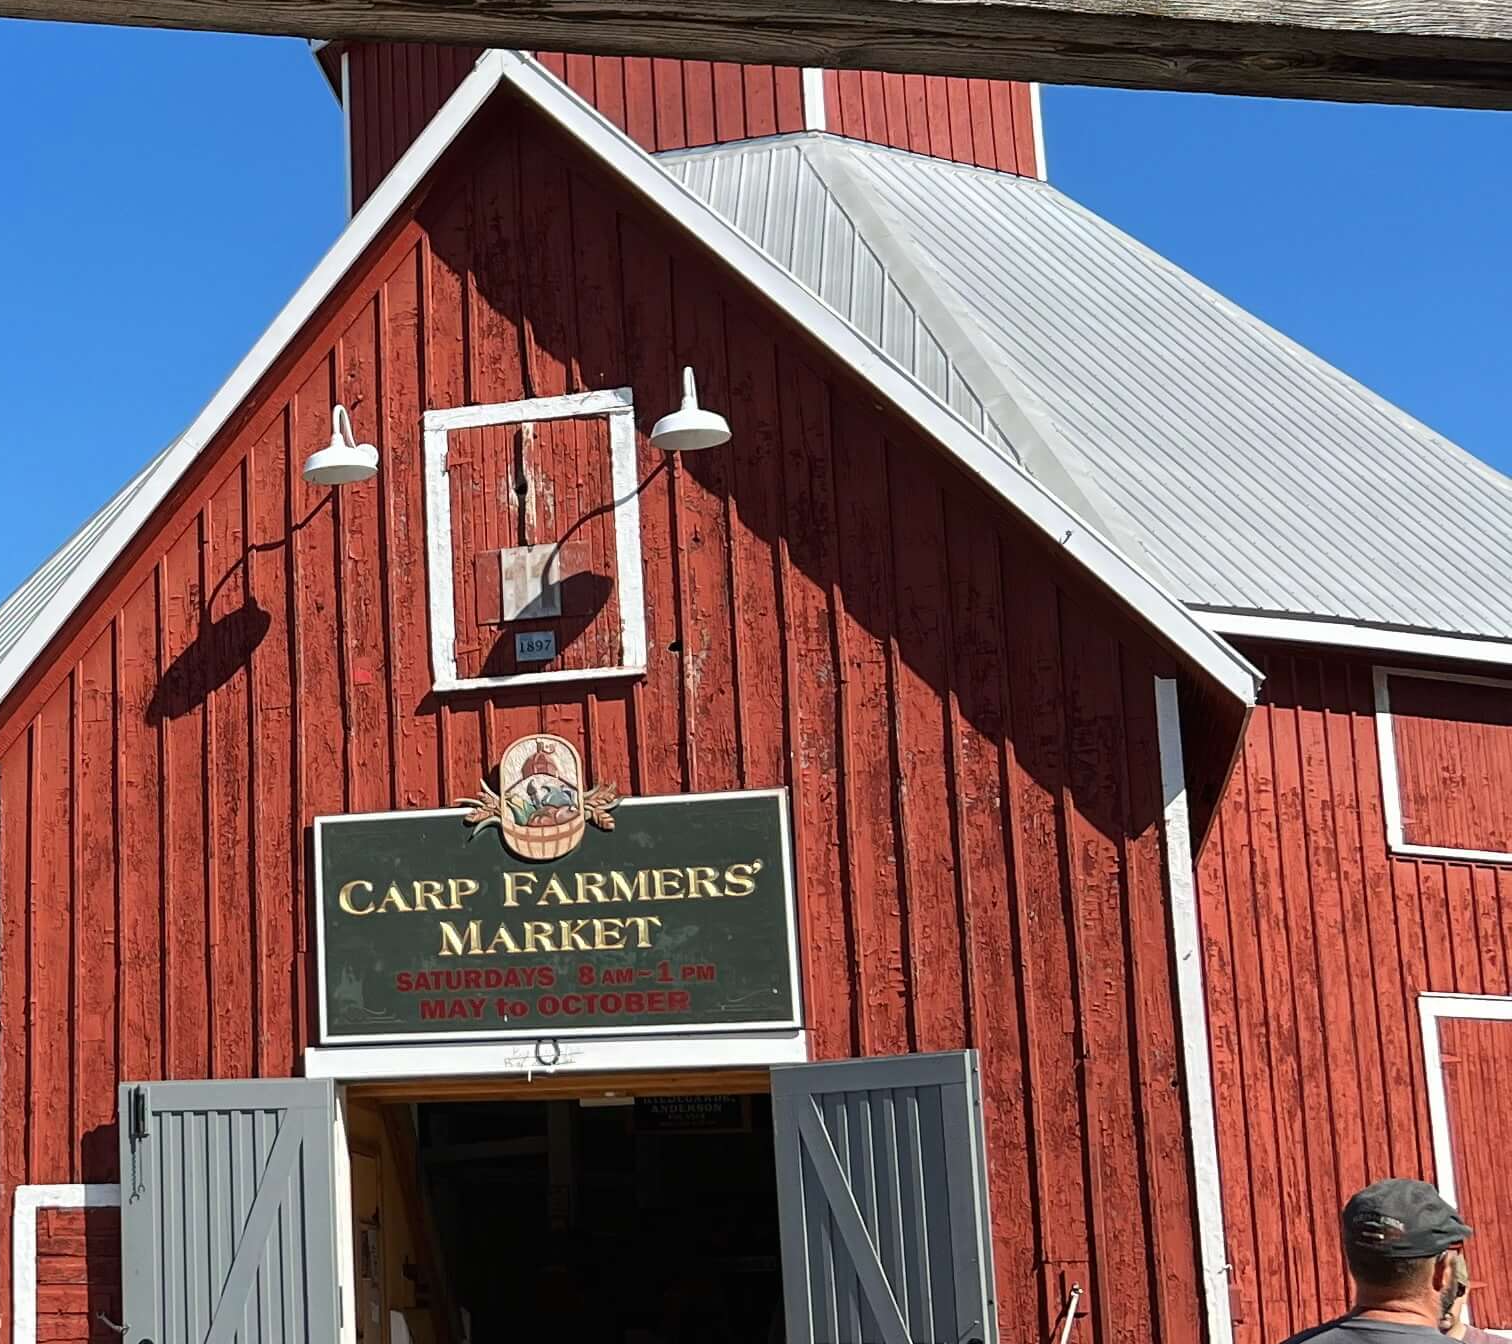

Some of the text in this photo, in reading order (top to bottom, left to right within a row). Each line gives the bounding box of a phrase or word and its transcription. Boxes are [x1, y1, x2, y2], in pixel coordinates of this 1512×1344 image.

[520, 640, 551, 653] 1897
[338, 859, 763, 915] CARP FARMERS'
[439, 916, 662, 956] MARKET
[396, 966, 556, 992] SATURDAYS
[578, 963, 595, 986] 8
[681, 965, 714, 981] PM
[420, 991, 691, 1020] MAY to OCTOBER
